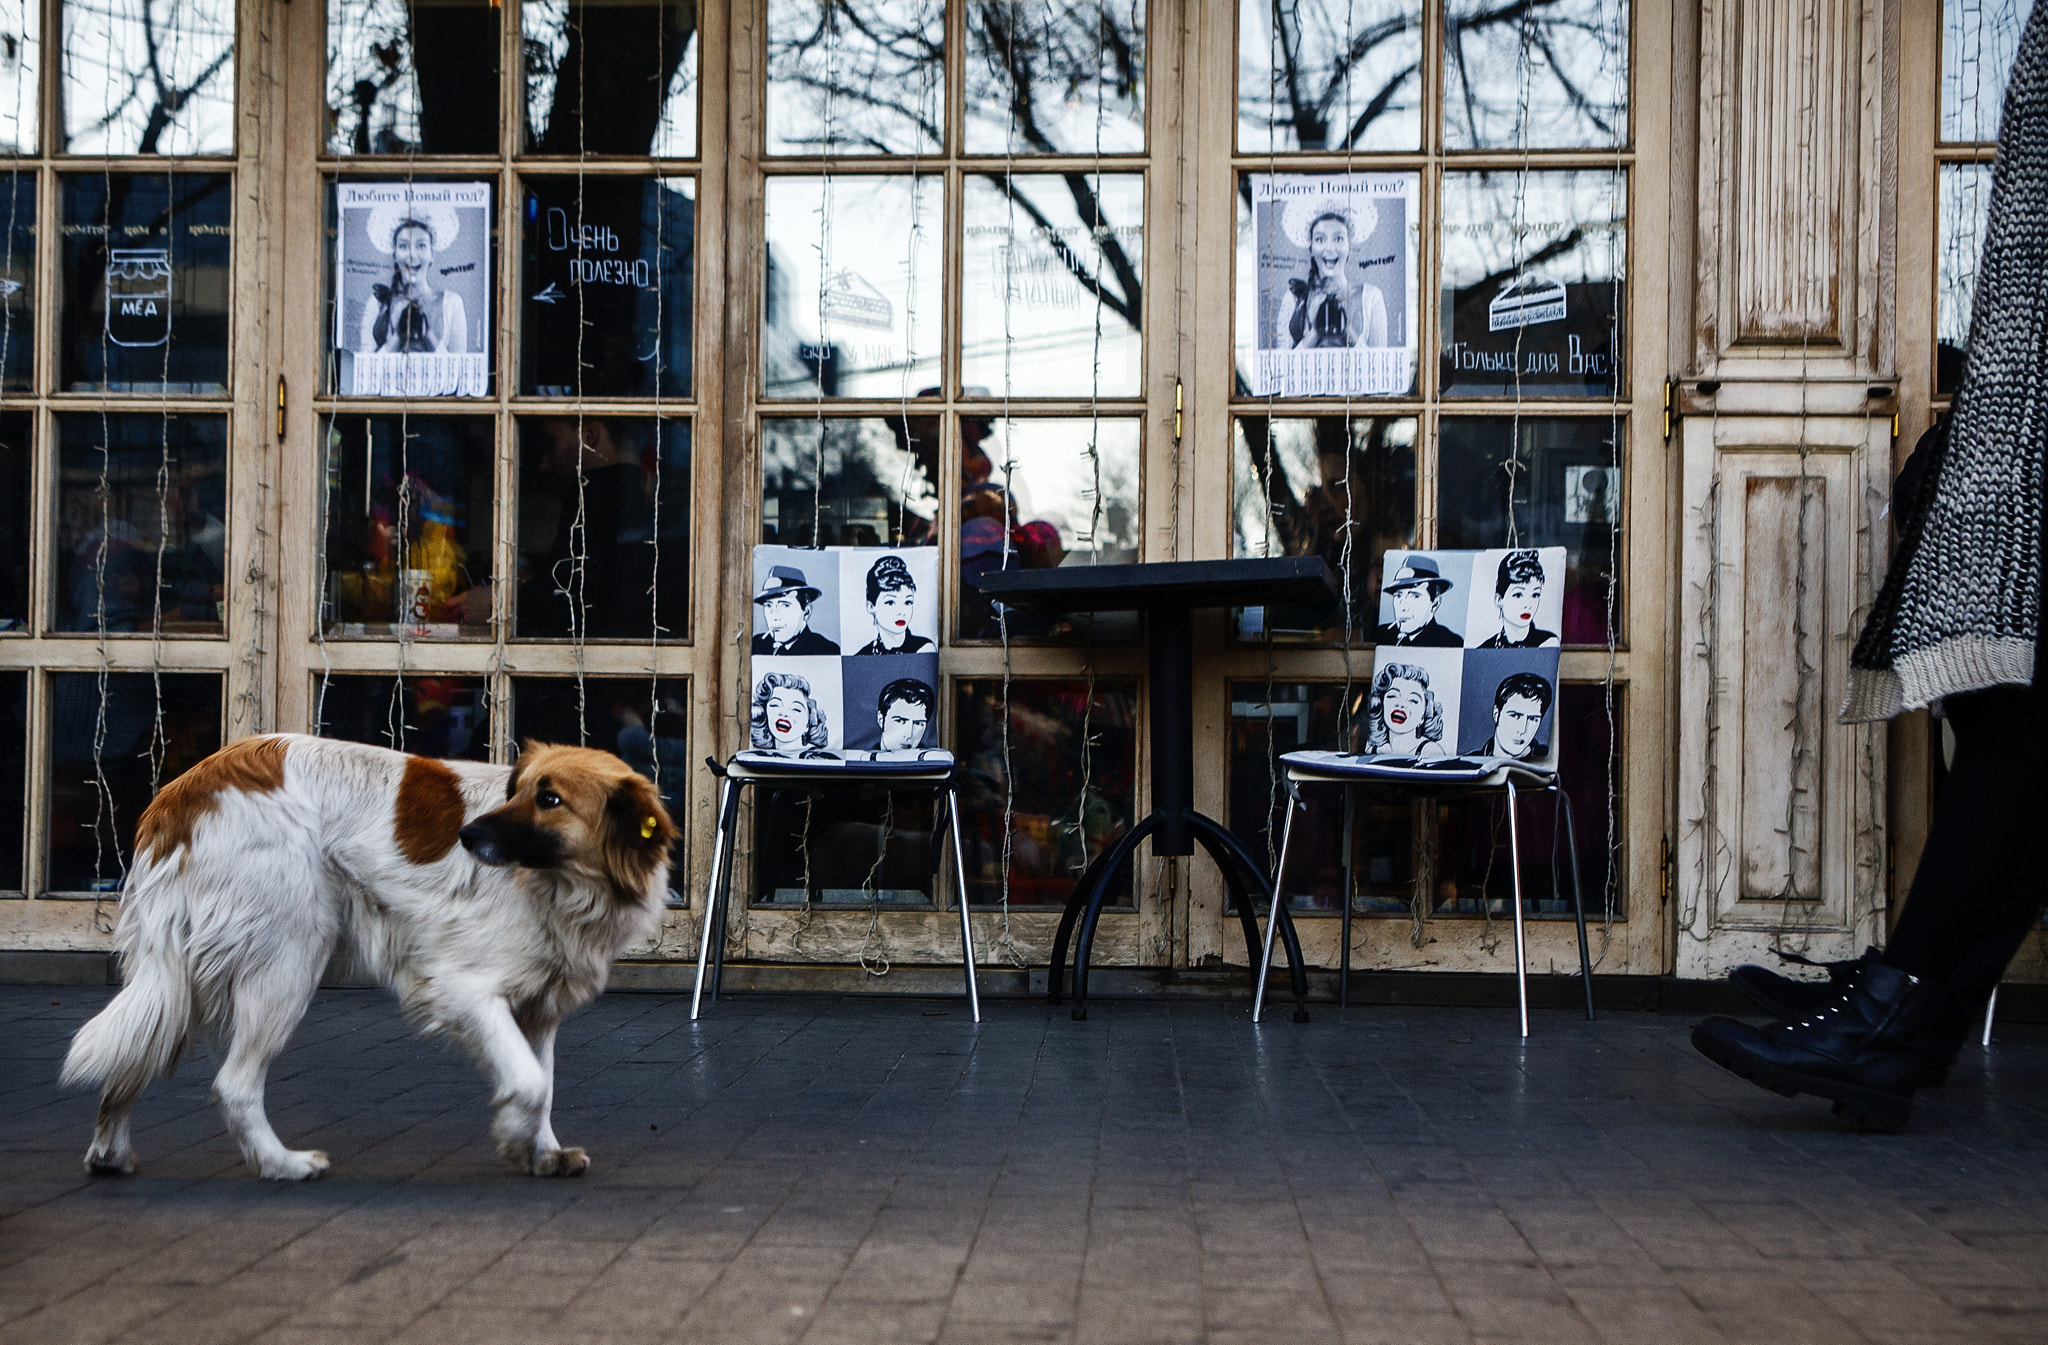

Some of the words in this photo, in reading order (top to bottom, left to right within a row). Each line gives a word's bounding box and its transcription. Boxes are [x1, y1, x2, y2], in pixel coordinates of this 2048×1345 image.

[346, 189, 401, 203] Любите
[404, 188, 451, 201] Новый
[455, 188, 485, 203] год?
[1259, 182, 1317, 196] Любите
[1320, 179, 1369, 195] Новый
[1373, 179, 1405, 194] год?
